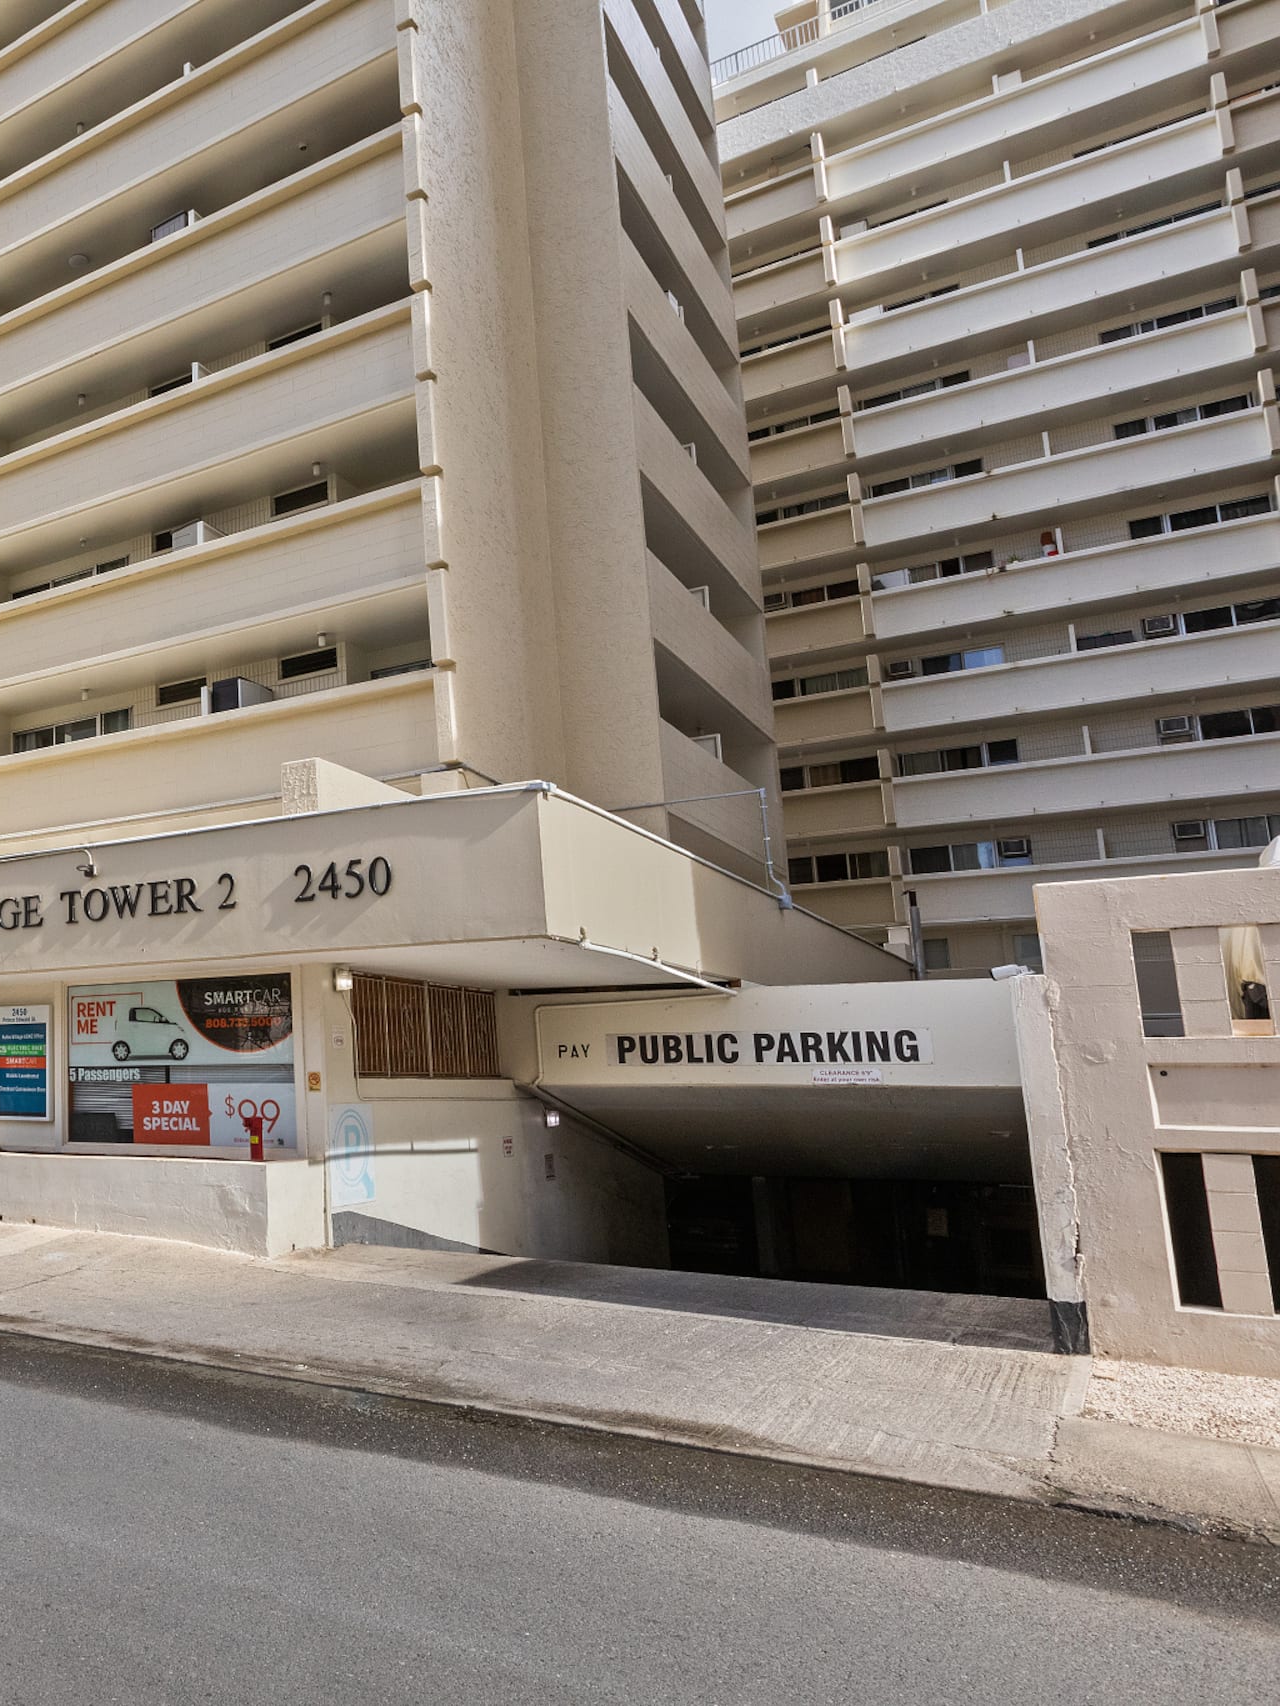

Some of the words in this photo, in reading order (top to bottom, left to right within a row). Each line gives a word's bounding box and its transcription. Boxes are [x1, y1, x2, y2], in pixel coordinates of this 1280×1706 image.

[60, 877, 204, 924] TOWER
[217, 872, 237, 909] 2
[293, 855, 393, 903] 2450
[11, 1008, 28, 1017] 2450
[77, 1000, 117, 1018] RENT
[77, 1018, 99, 1035] ME
[557, 1043, 591, 1059] PAY
[616, 1033, 739, 1064] PUBLIC
[753, 1029, 920, 1063] PARKING
[69, 1068, 77, 1081] 5
[78, 1067, 141, 1081] Passengers
[151, 1100, 160, 1114] 3
[163, 1100, 190, 1114] DAY
[143, 1117, 201, 1131] SPECIAL
